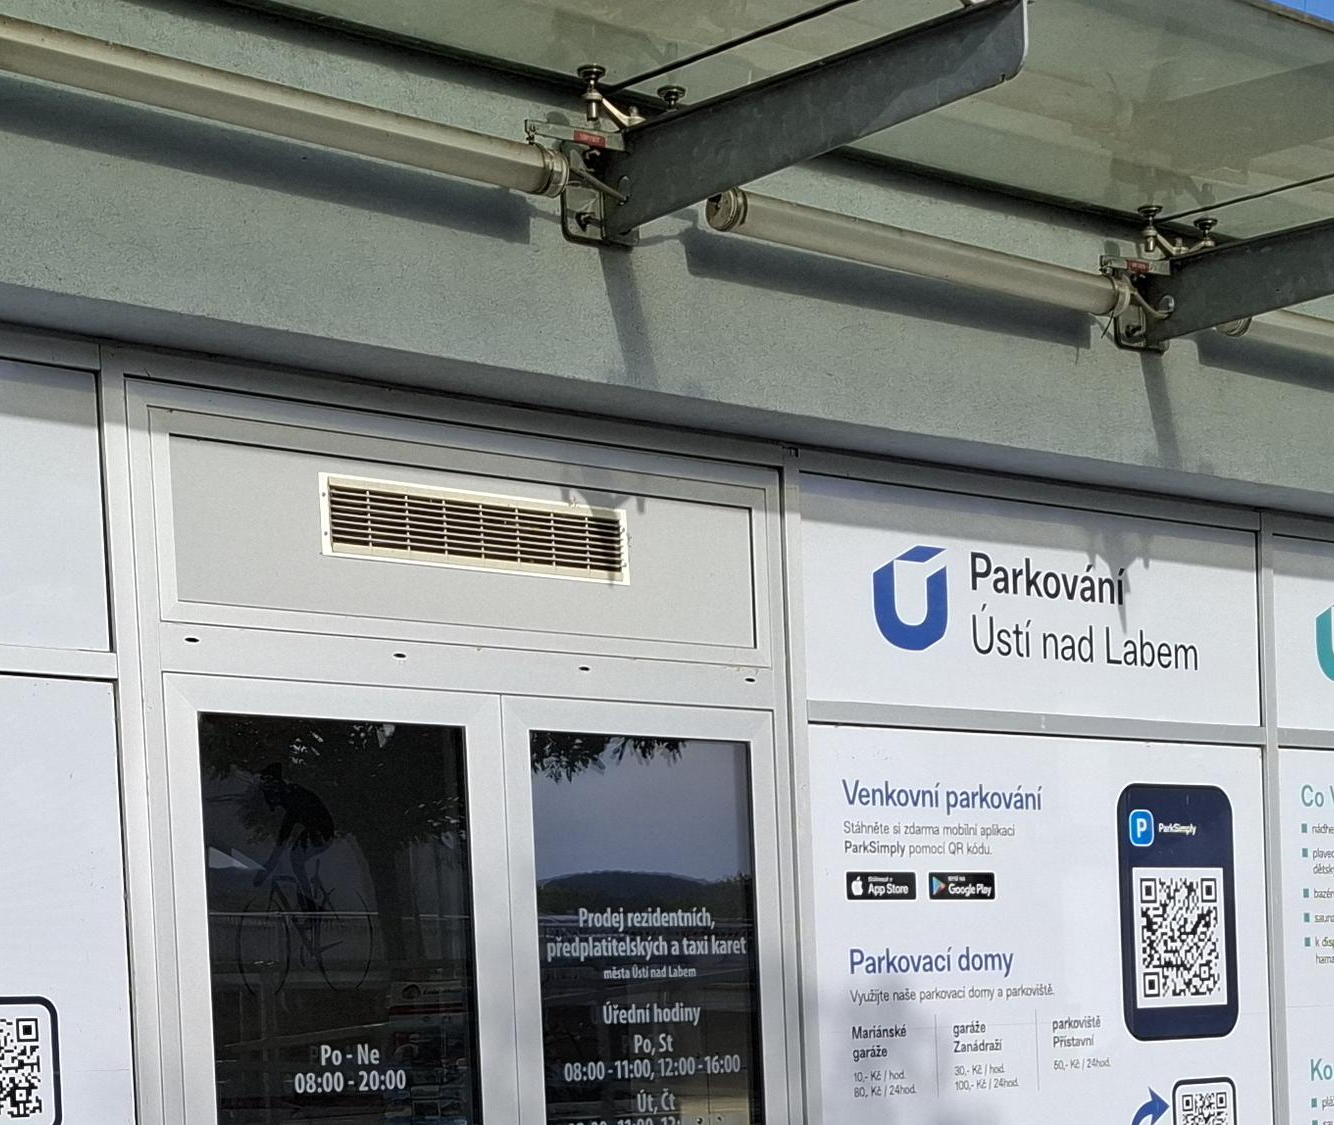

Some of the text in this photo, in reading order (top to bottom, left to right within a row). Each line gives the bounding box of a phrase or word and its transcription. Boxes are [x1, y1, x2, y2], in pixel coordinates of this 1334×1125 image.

[970, 551, 1126, 606] Parkování
[972, 604, 1199, 671] Ústí nad Labem
[842, 779, 1042, 816] Venkovní parkování
[1301, 784, 1325, 808] Co
[844, 840, 906, 857] ParkSimply
[908, 841, 945, 857] pomocí
[948, 842, 964, 855] QR
[578, 907, 715, 931] Prodej rezidentních,
[547, 936, 747, 962] předplatitelských a taxi karet
[603, 966, 697, 979] města Ústí nad Labem
[849, 947, 1014, 978] Parkovací domy
[603, 1001, 701, 1026] Úřední hodiny
[1052, 1015, 1101, 1033] parkoviště
[852, 1024, 907, 1039] Mariánské
[953, 1020, 986, 1038] garáže
[634, 1034, 674, 1055] Po, St
[953, 1038, 1002, 1053] Zanádraží
[1053, 1034, 1094, 1048] Přístavní
[321, 1045, 342, 1066] Po
[357, 1045, 380, 1066] Ne
[853, 1045, 887, 1062] garáže
[295, 1071, 344, 1095] 08:00
[357, 1070, 407, 1092] 20:00
[661, 1088, 676, 1111] Čt
